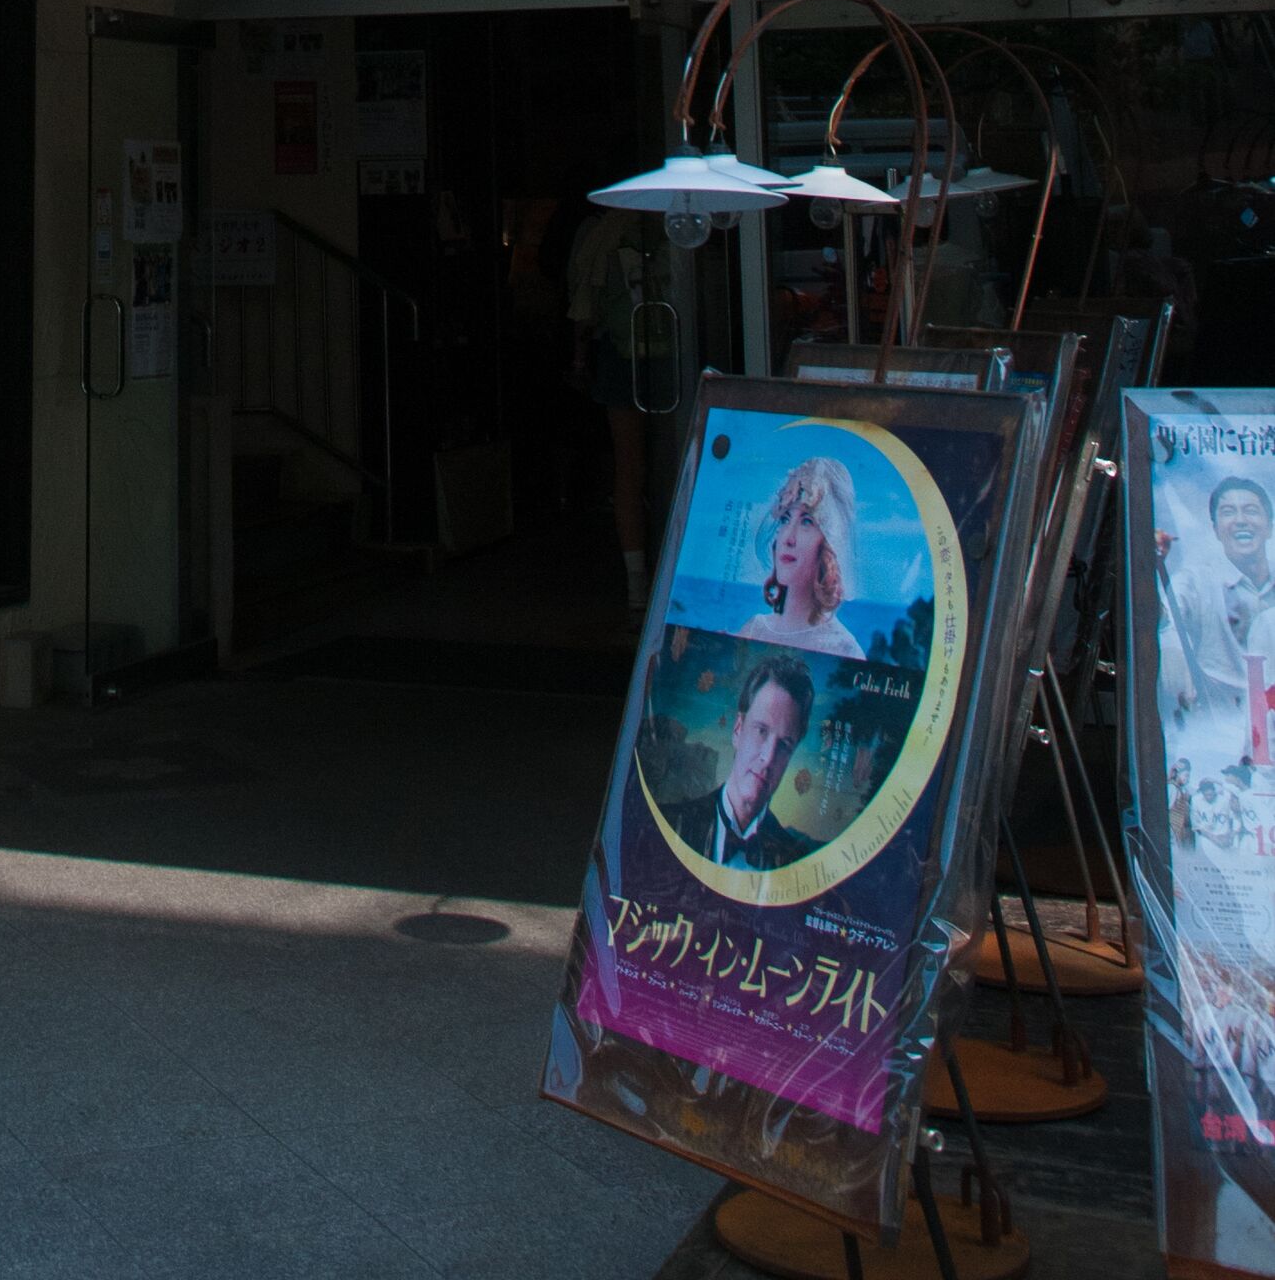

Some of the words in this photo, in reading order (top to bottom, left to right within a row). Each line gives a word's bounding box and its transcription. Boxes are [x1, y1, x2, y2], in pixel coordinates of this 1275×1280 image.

[852, 670, 881, 694] Colin
[884, 675, 911, 700] Firth
[840, 788, 914, 871] Moonlight
